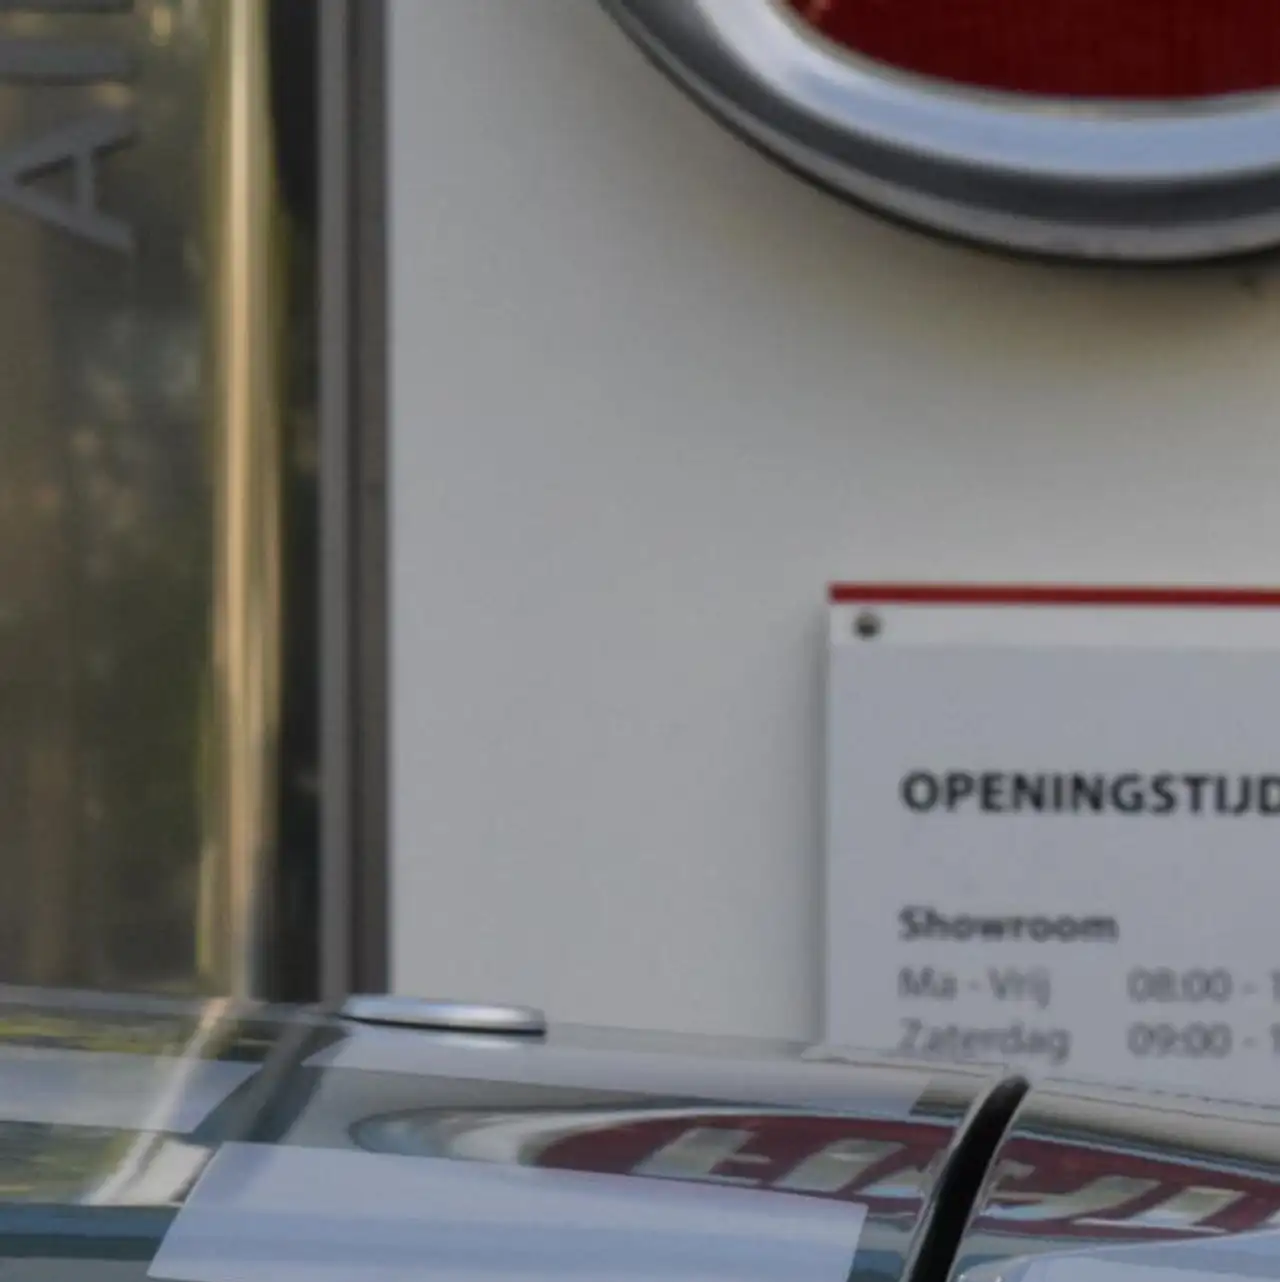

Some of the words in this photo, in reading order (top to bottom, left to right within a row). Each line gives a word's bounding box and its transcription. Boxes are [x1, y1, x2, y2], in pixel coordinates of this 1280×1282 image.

[897, 905, 1120, 943] Showroom
[898, 967, 958, 999] Ma
[987, 965, 1052, 1009] Vrij
[1126, 967, 1233, 1004] 08:00
[898, 1018, 1071, 1062] Zaterdag
[1126, 1021, 1233, 1058] 09:00
